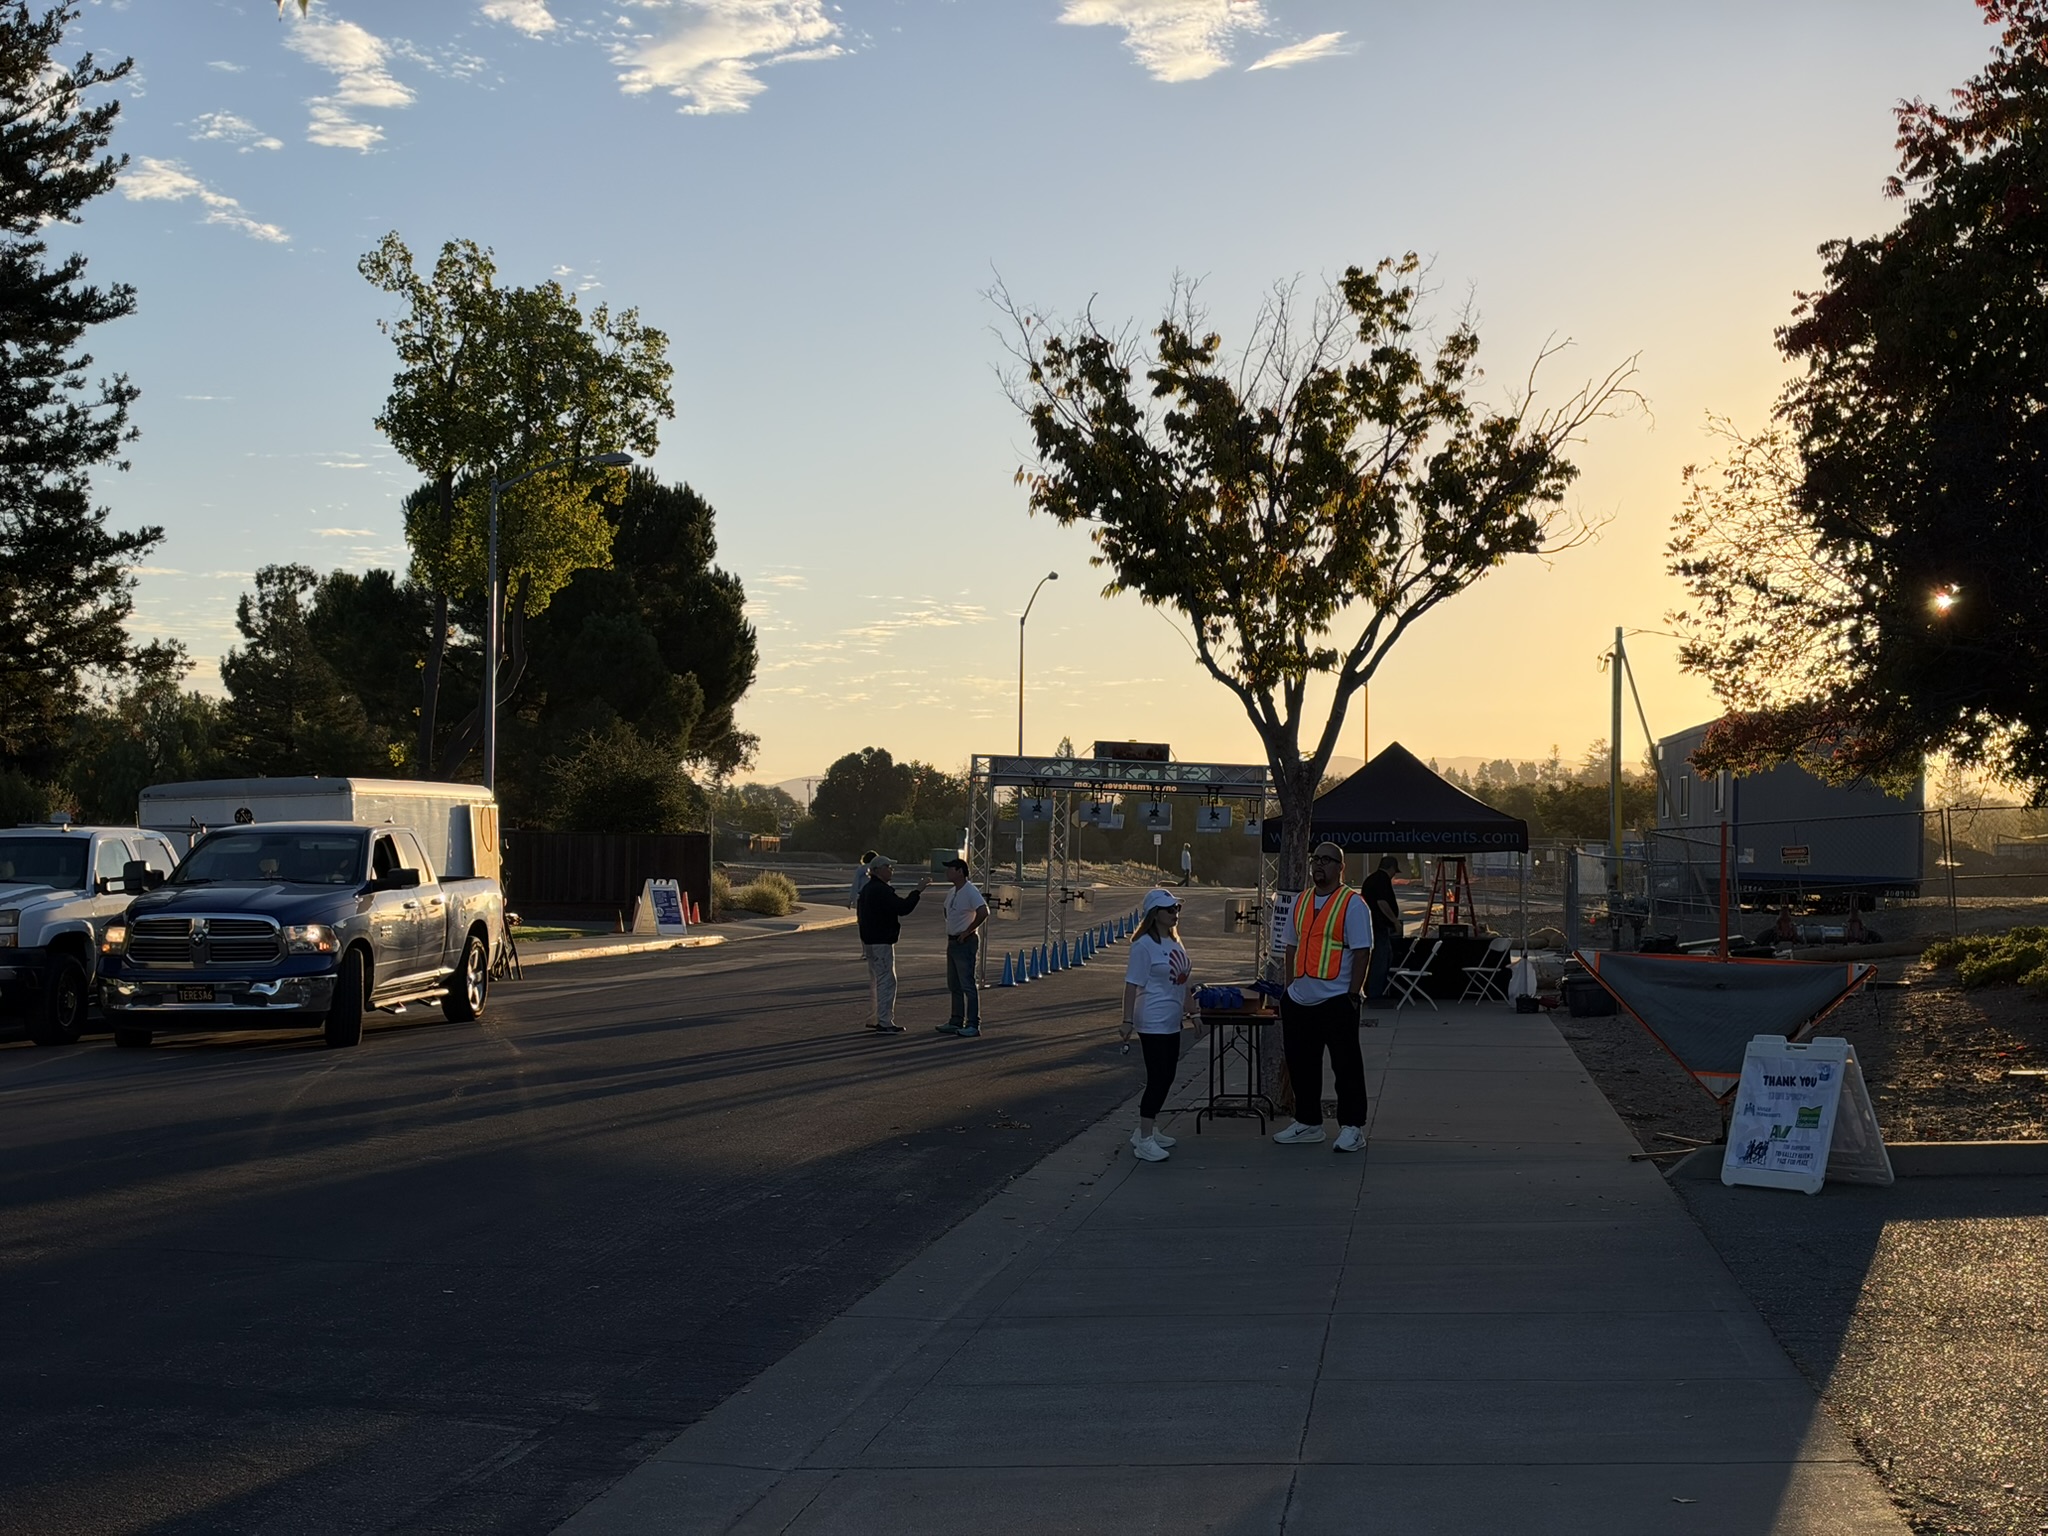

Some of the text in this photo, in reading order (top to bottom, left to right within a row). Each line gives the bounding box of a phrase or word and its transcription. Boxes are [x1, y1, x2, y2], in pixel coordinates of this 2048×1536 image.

[1270, 828, 1519, 847] w.onyourmarkevents.com
[1281, 895, 1292, 904] NO
[1274, 906, 1289, 915] PARK
[179, 990, 213, 1001] TERESA6
[1763, 1075, 1797, 1087] THANK
[1799, 1076, 1818, 1088] YOU
